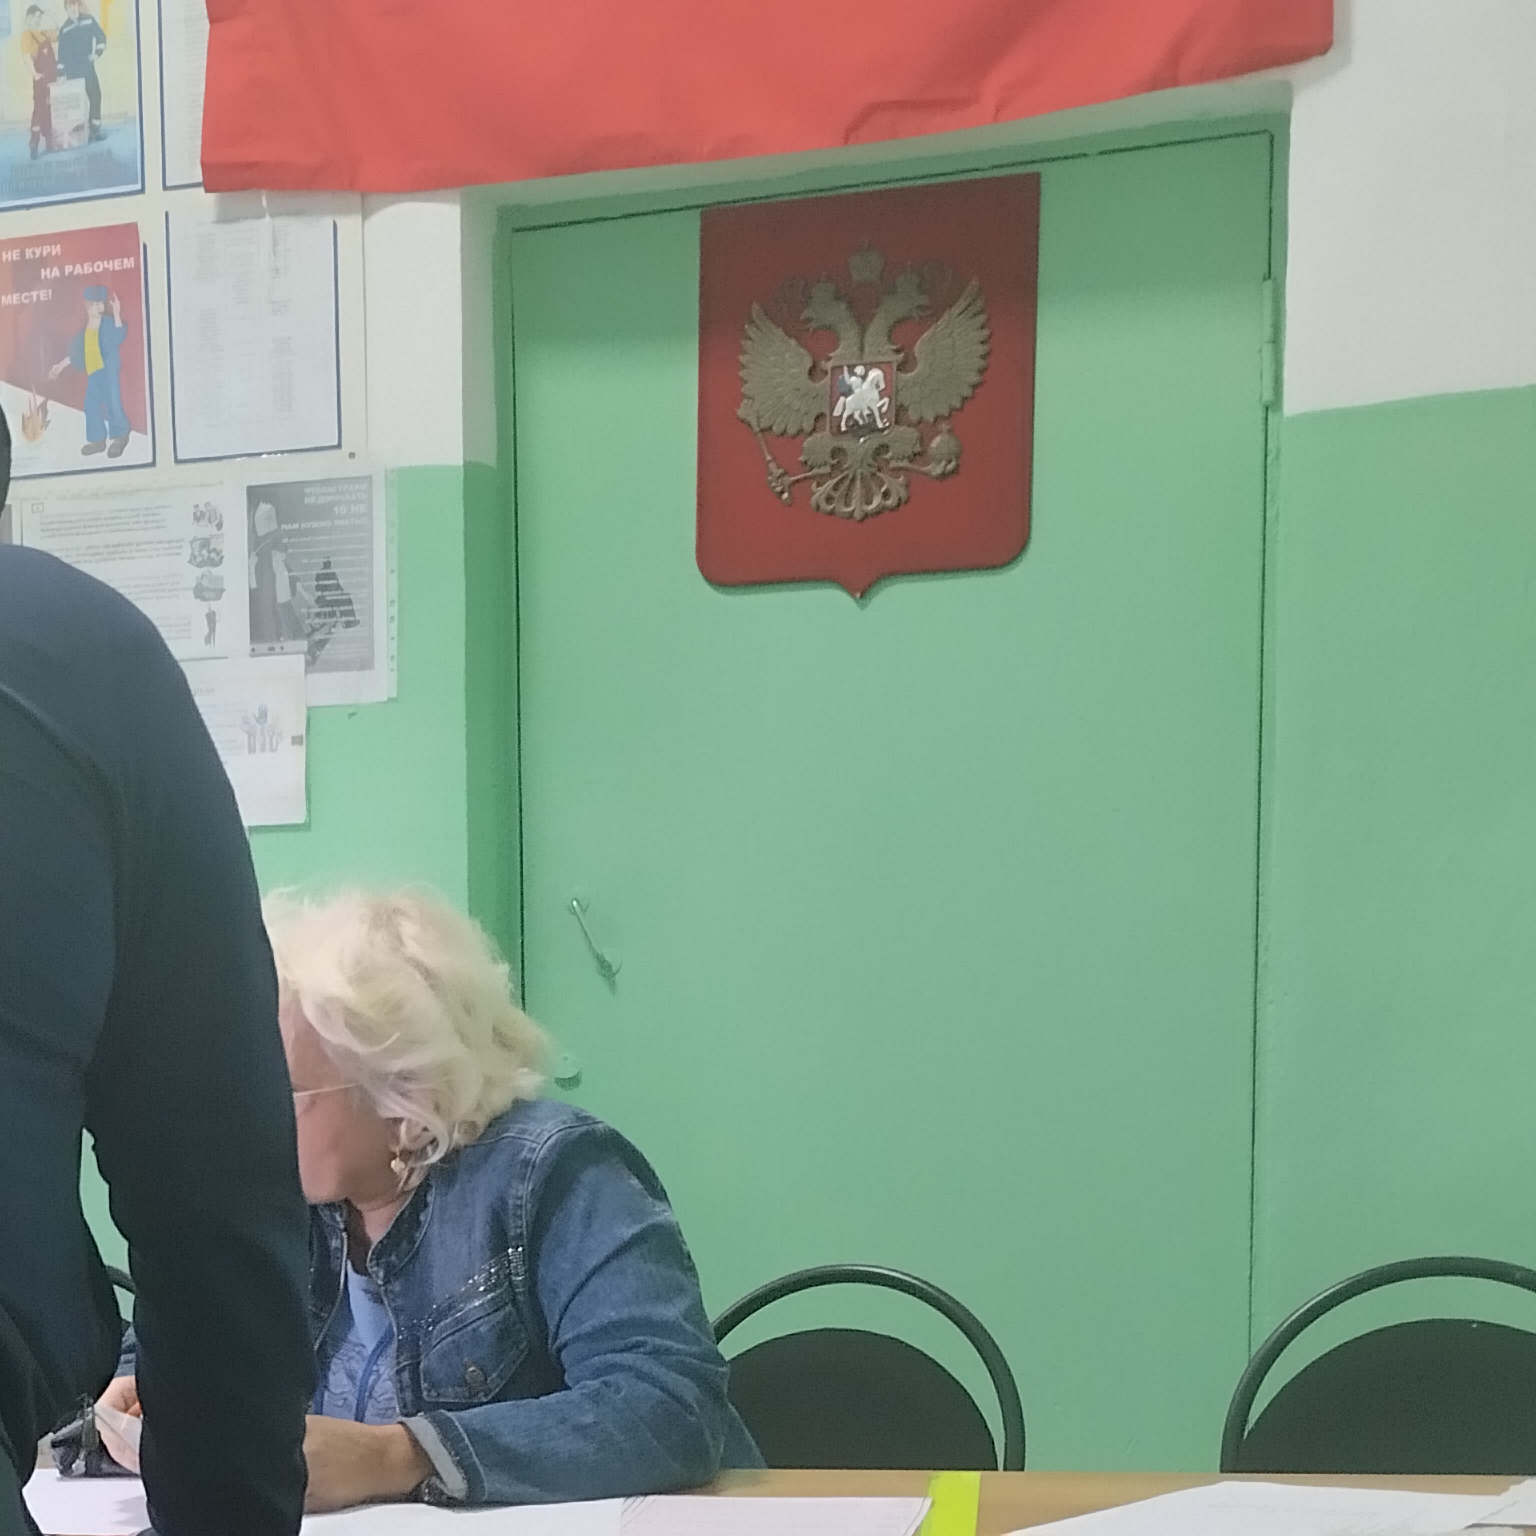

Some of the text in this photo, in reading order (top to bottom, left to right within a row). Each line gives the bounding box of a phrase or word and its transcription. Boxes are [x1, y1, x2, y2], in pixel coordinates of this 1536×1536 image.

[2, 244, 61, 263] НЕ КУРИ
[41, 257, 135, 280] НА РАБОЧЕМ
[1, 289, 52, 306] МЕСТЕ!
